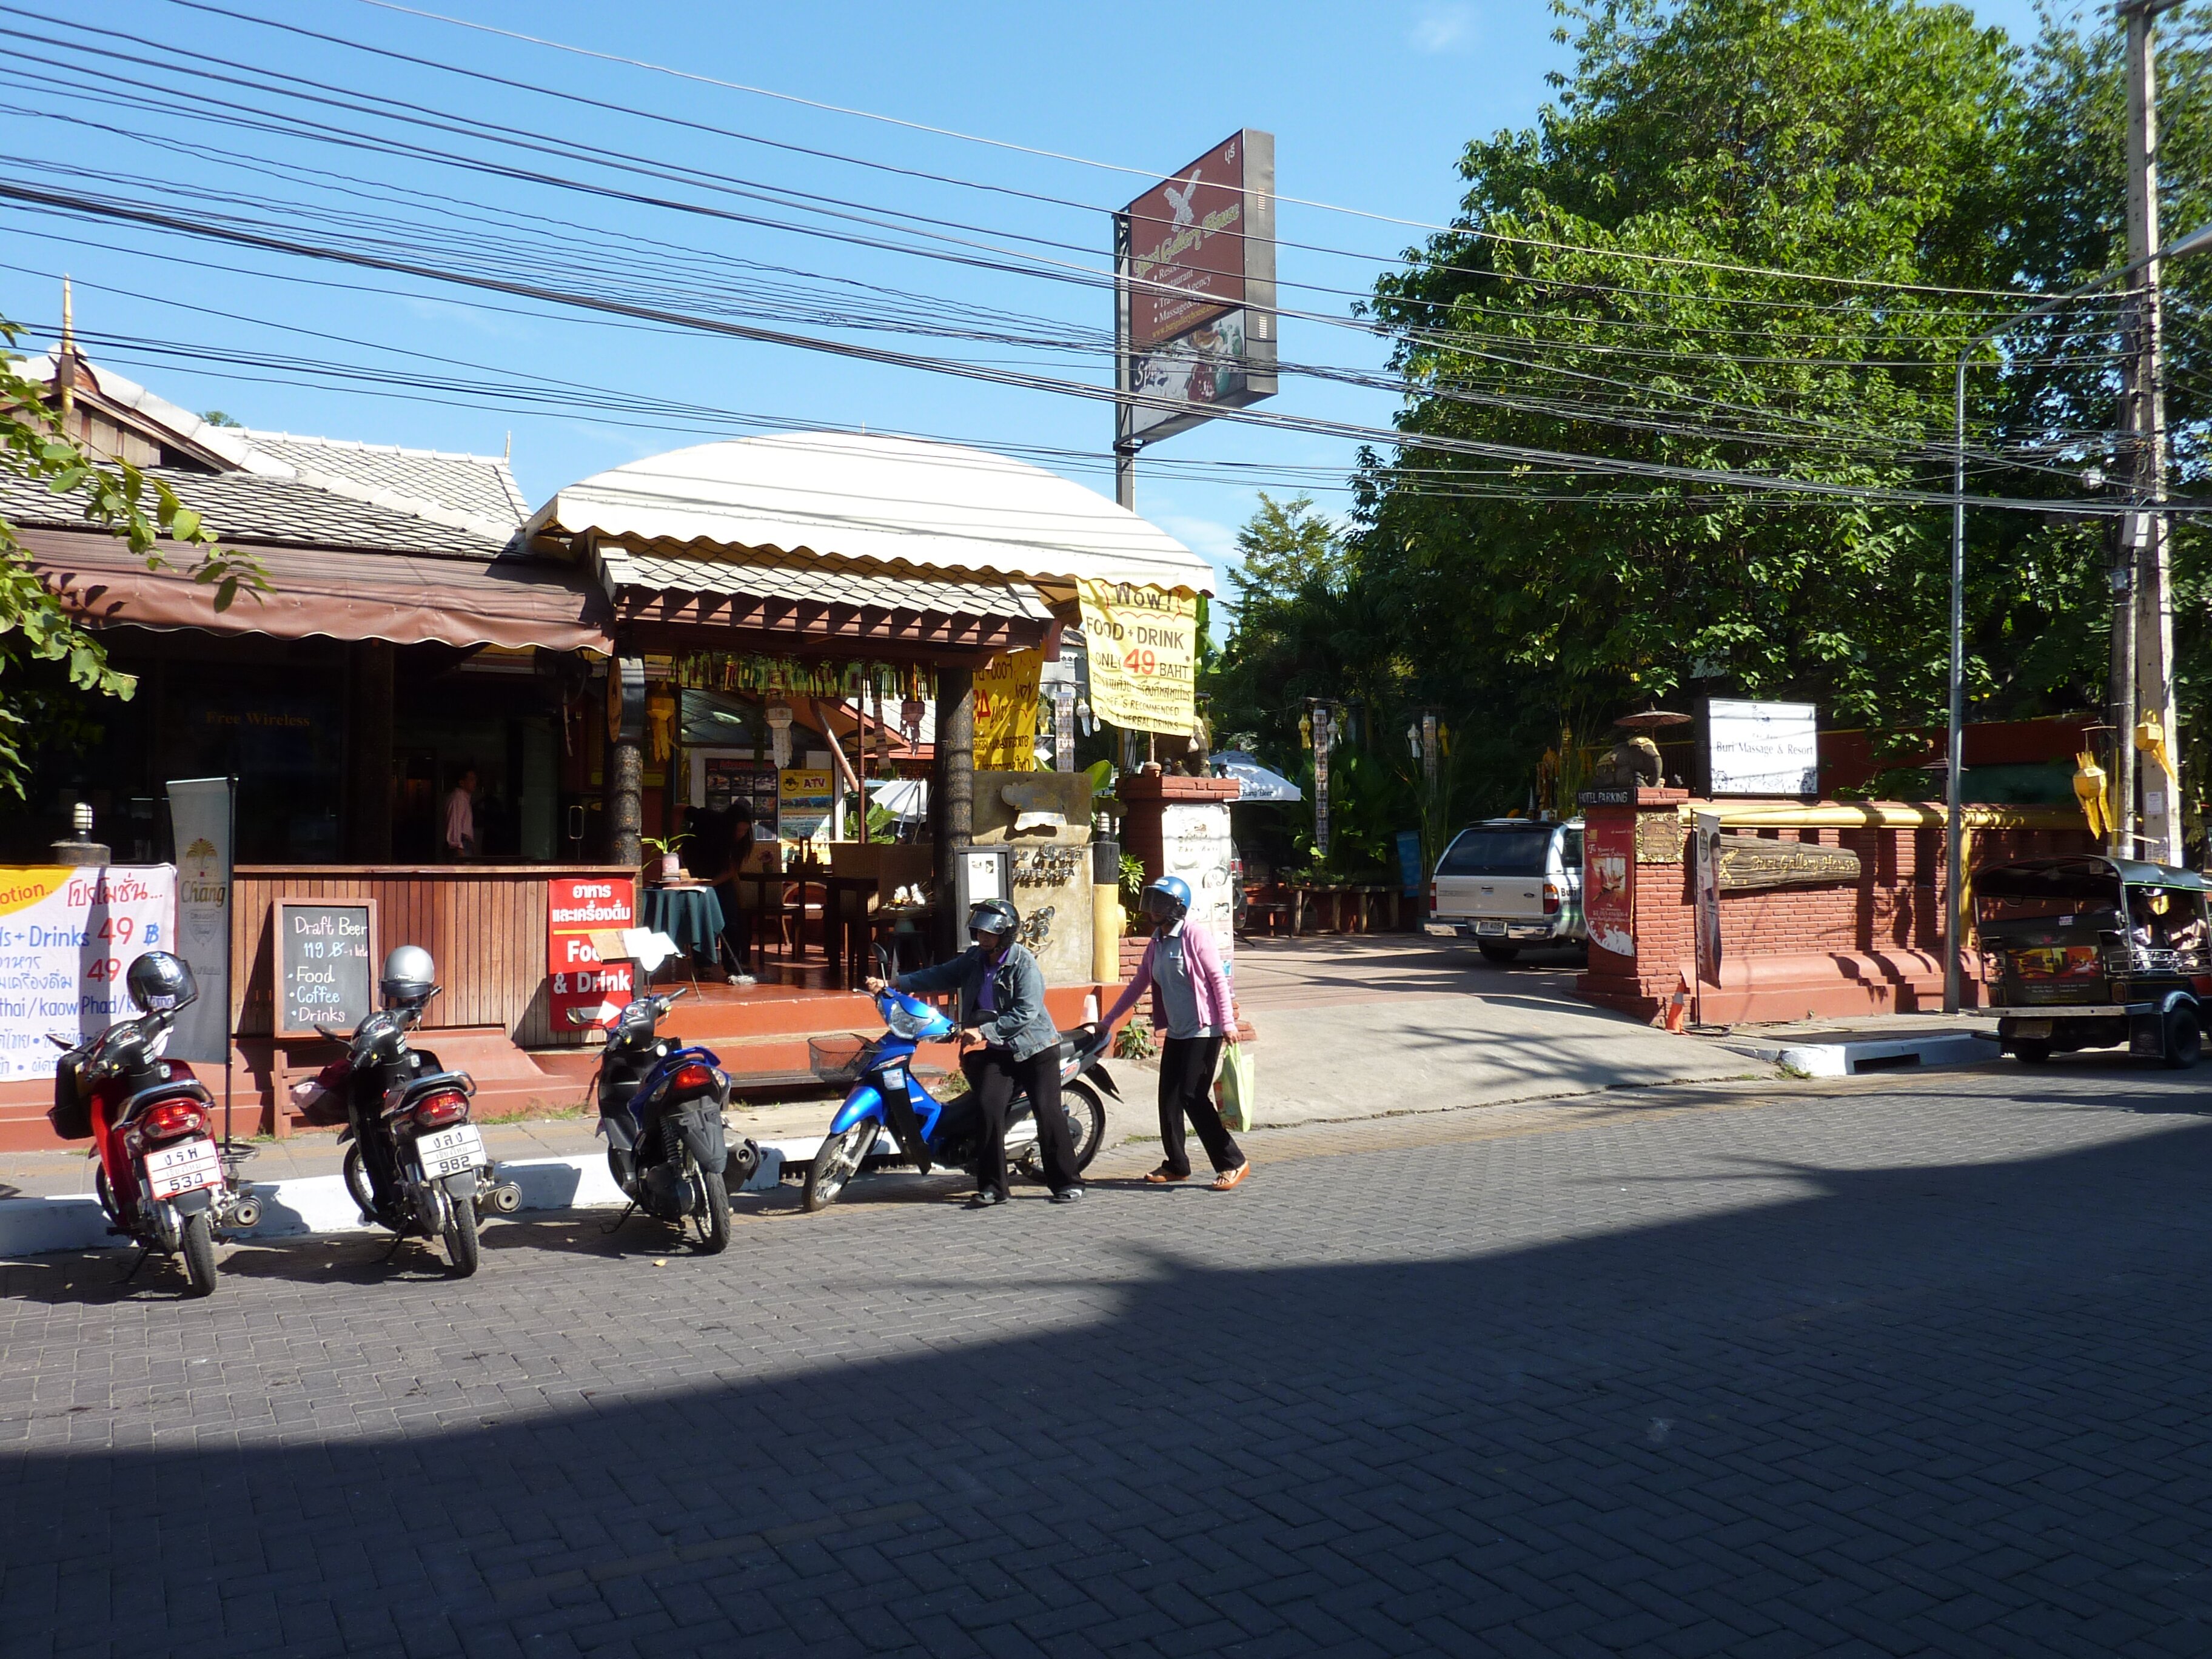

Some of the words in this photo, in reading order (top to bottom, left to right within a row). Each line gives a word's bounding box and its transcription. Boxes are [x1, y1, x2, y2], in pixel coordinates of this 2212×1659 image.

[1086, 616, 1124, 641] FOOD
[1137, 626, 1184, 650] DRINK
[1096, 652, 1121, 670] ONLY
[1123, 649, 1155, 675] 49
[1159, 663, 1189, 679] BAHT
[1130, 700, 1179, 716] RECOMMENDED
[206, 711, 240, 724] Free
[246, 711, 310, 726] Wireless
[1124, 716, 1150, 728] HERBAL
[1153, 719, 1179, 730] DRINKS
[1717, 742, 1734, 752] Buri
[1739, 742, 1773, 757] Massage
[1777, 744, 1783, 754] &
[1788, 744, 1812, 755] Resort
[803, 778, 825, 788] ATV
[1578, 792, 1597, 803] HOTEL
[1598, 791, 1627, 803] PARKING
[1751, 855, 1777, 870] Buri
[1780, 853, 1818, 874] Gallery
[1822, 854, 1855, 871] House
[181, 881, 226, 907] Chang
[572, 885, 612, 898] อาหาร
[1561, 886, 1577, 897] Buri
[552, 899, 631, 922] และเครื่องดื่ม
[30, 925, 90, 947] Drinks
[97, 917, 134, 945] 49
[295, 916, 334, 936] Draft
[339, 917, 367, 937] Beer
[304, 942, 324, 959] 119
[87, 958, 121, 982] 49
[297, 965, 336, 983] Food
[554, 972, 568, 994] &
[577, 970, 631, 993] Drink
[297, 985, 340, 1004] Coffee
[299, 1007, 346, 1022] Drinks
[440, 1156, 471, 1173] 982
[170, 1173, 203, 1191] 534
